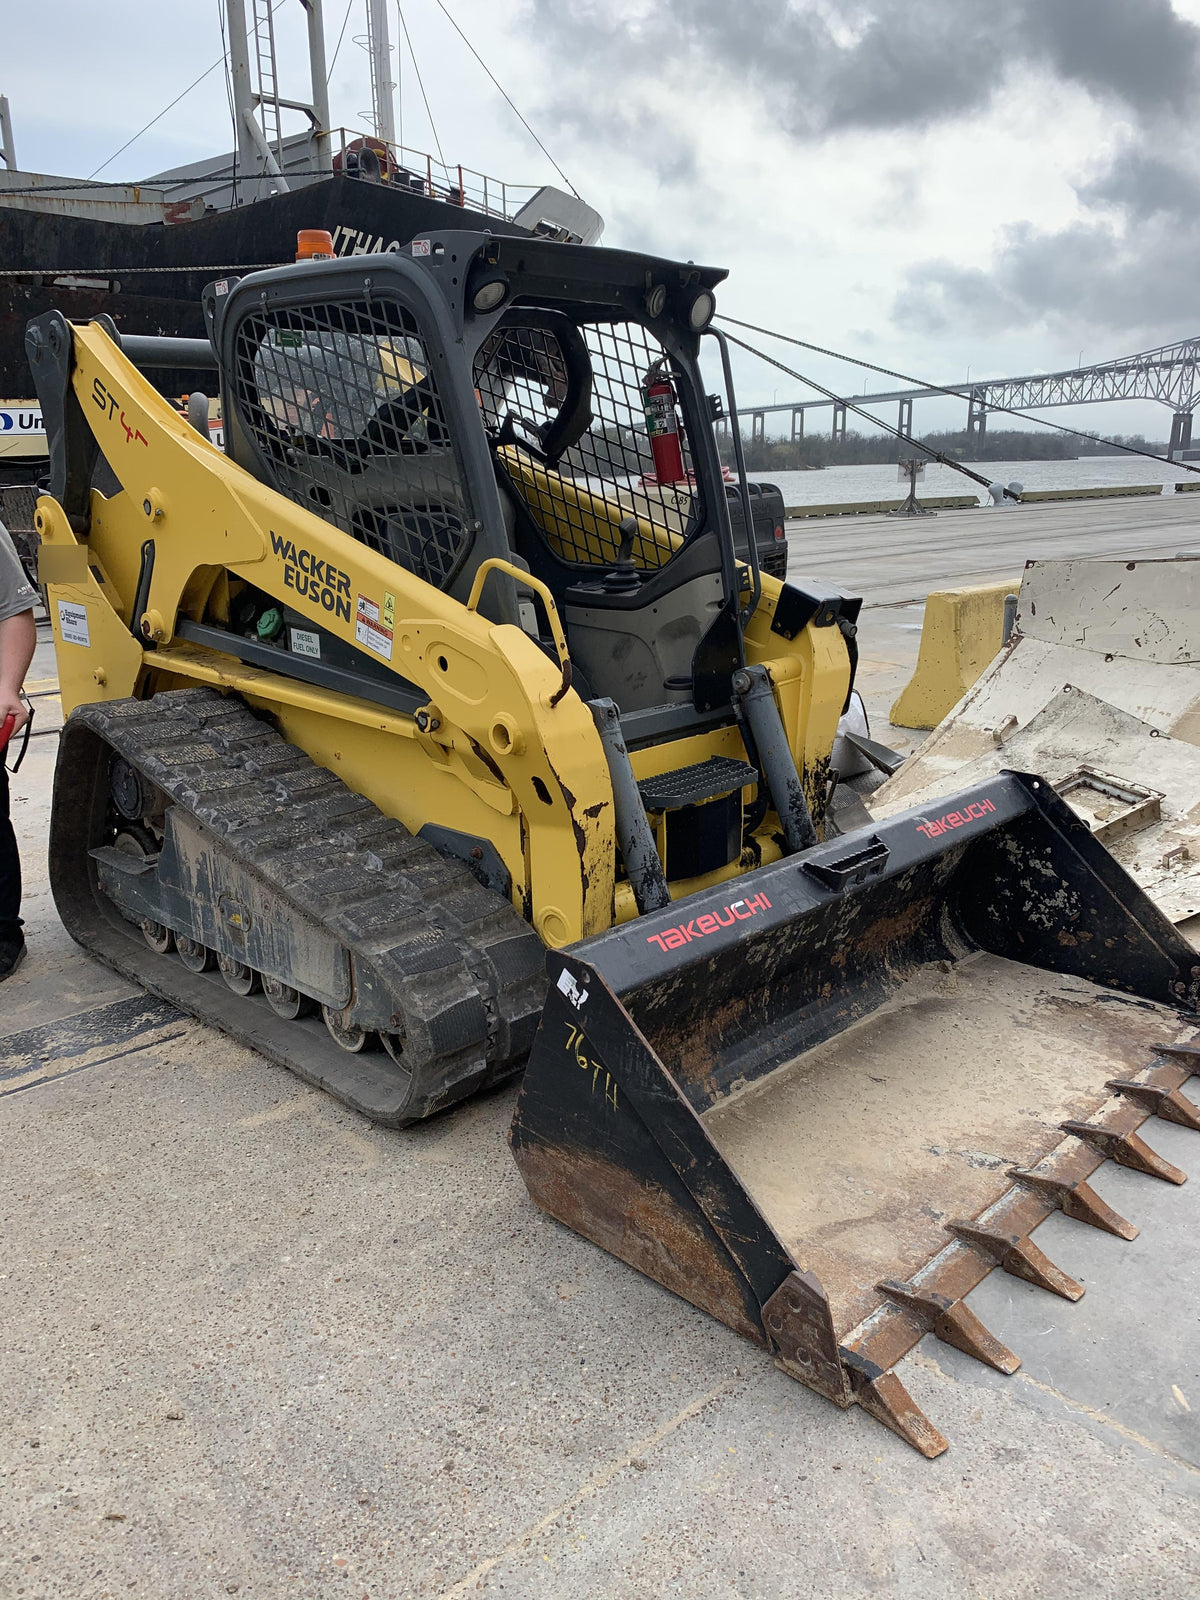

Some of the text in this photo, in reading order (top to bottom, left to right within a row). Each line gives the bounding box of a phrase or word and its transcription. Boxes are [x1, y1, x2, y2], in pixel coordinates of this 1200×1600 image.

[670, 496, 688, 506] C85
[270, 530, 351, 600] WACKER
[297, 633, 313, 643] DIESEL
[293, 642, 319, 654] FUEL ONLY
